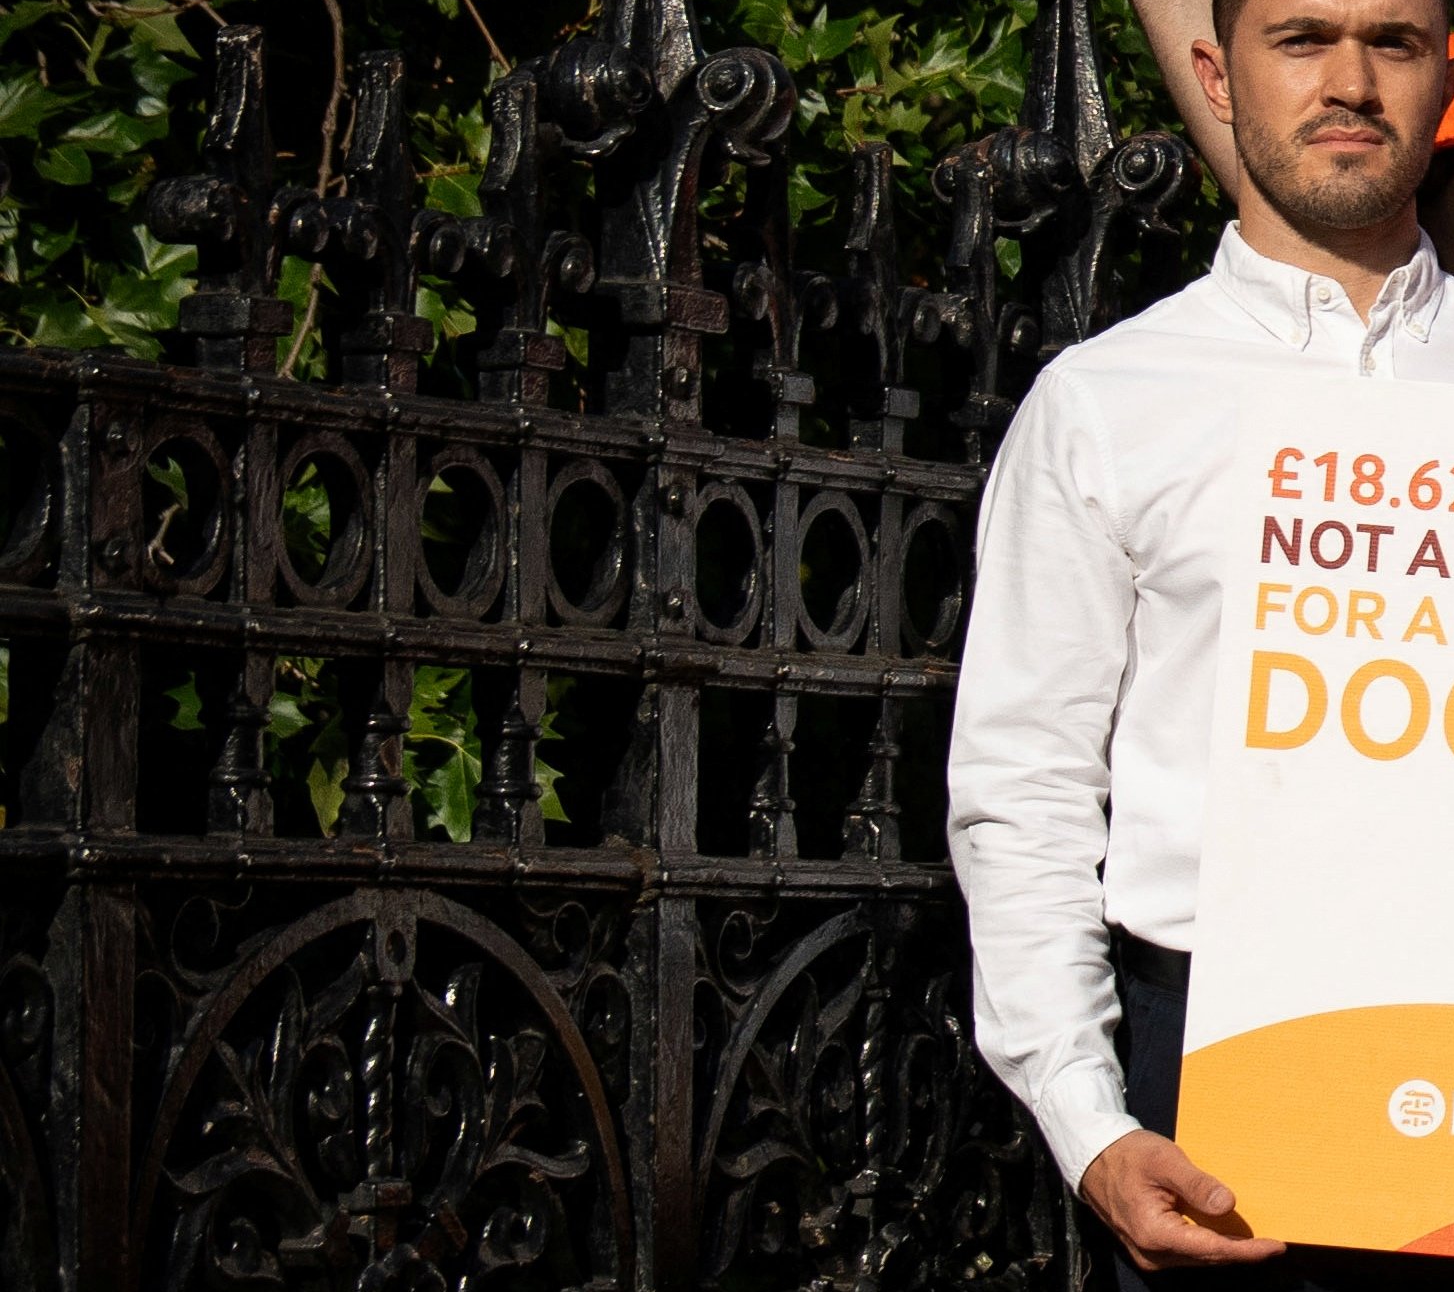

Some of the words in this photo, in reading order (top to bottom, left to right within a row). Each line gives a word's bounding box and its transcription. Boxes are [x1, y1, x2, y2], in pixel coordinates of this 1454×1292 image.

[1258, 516, 1395, 574] NOT
[1406, 530, 1453, 579] A
[1255, 582, 1386, 641] FOR
[1402, 599, 1450, 646] A
